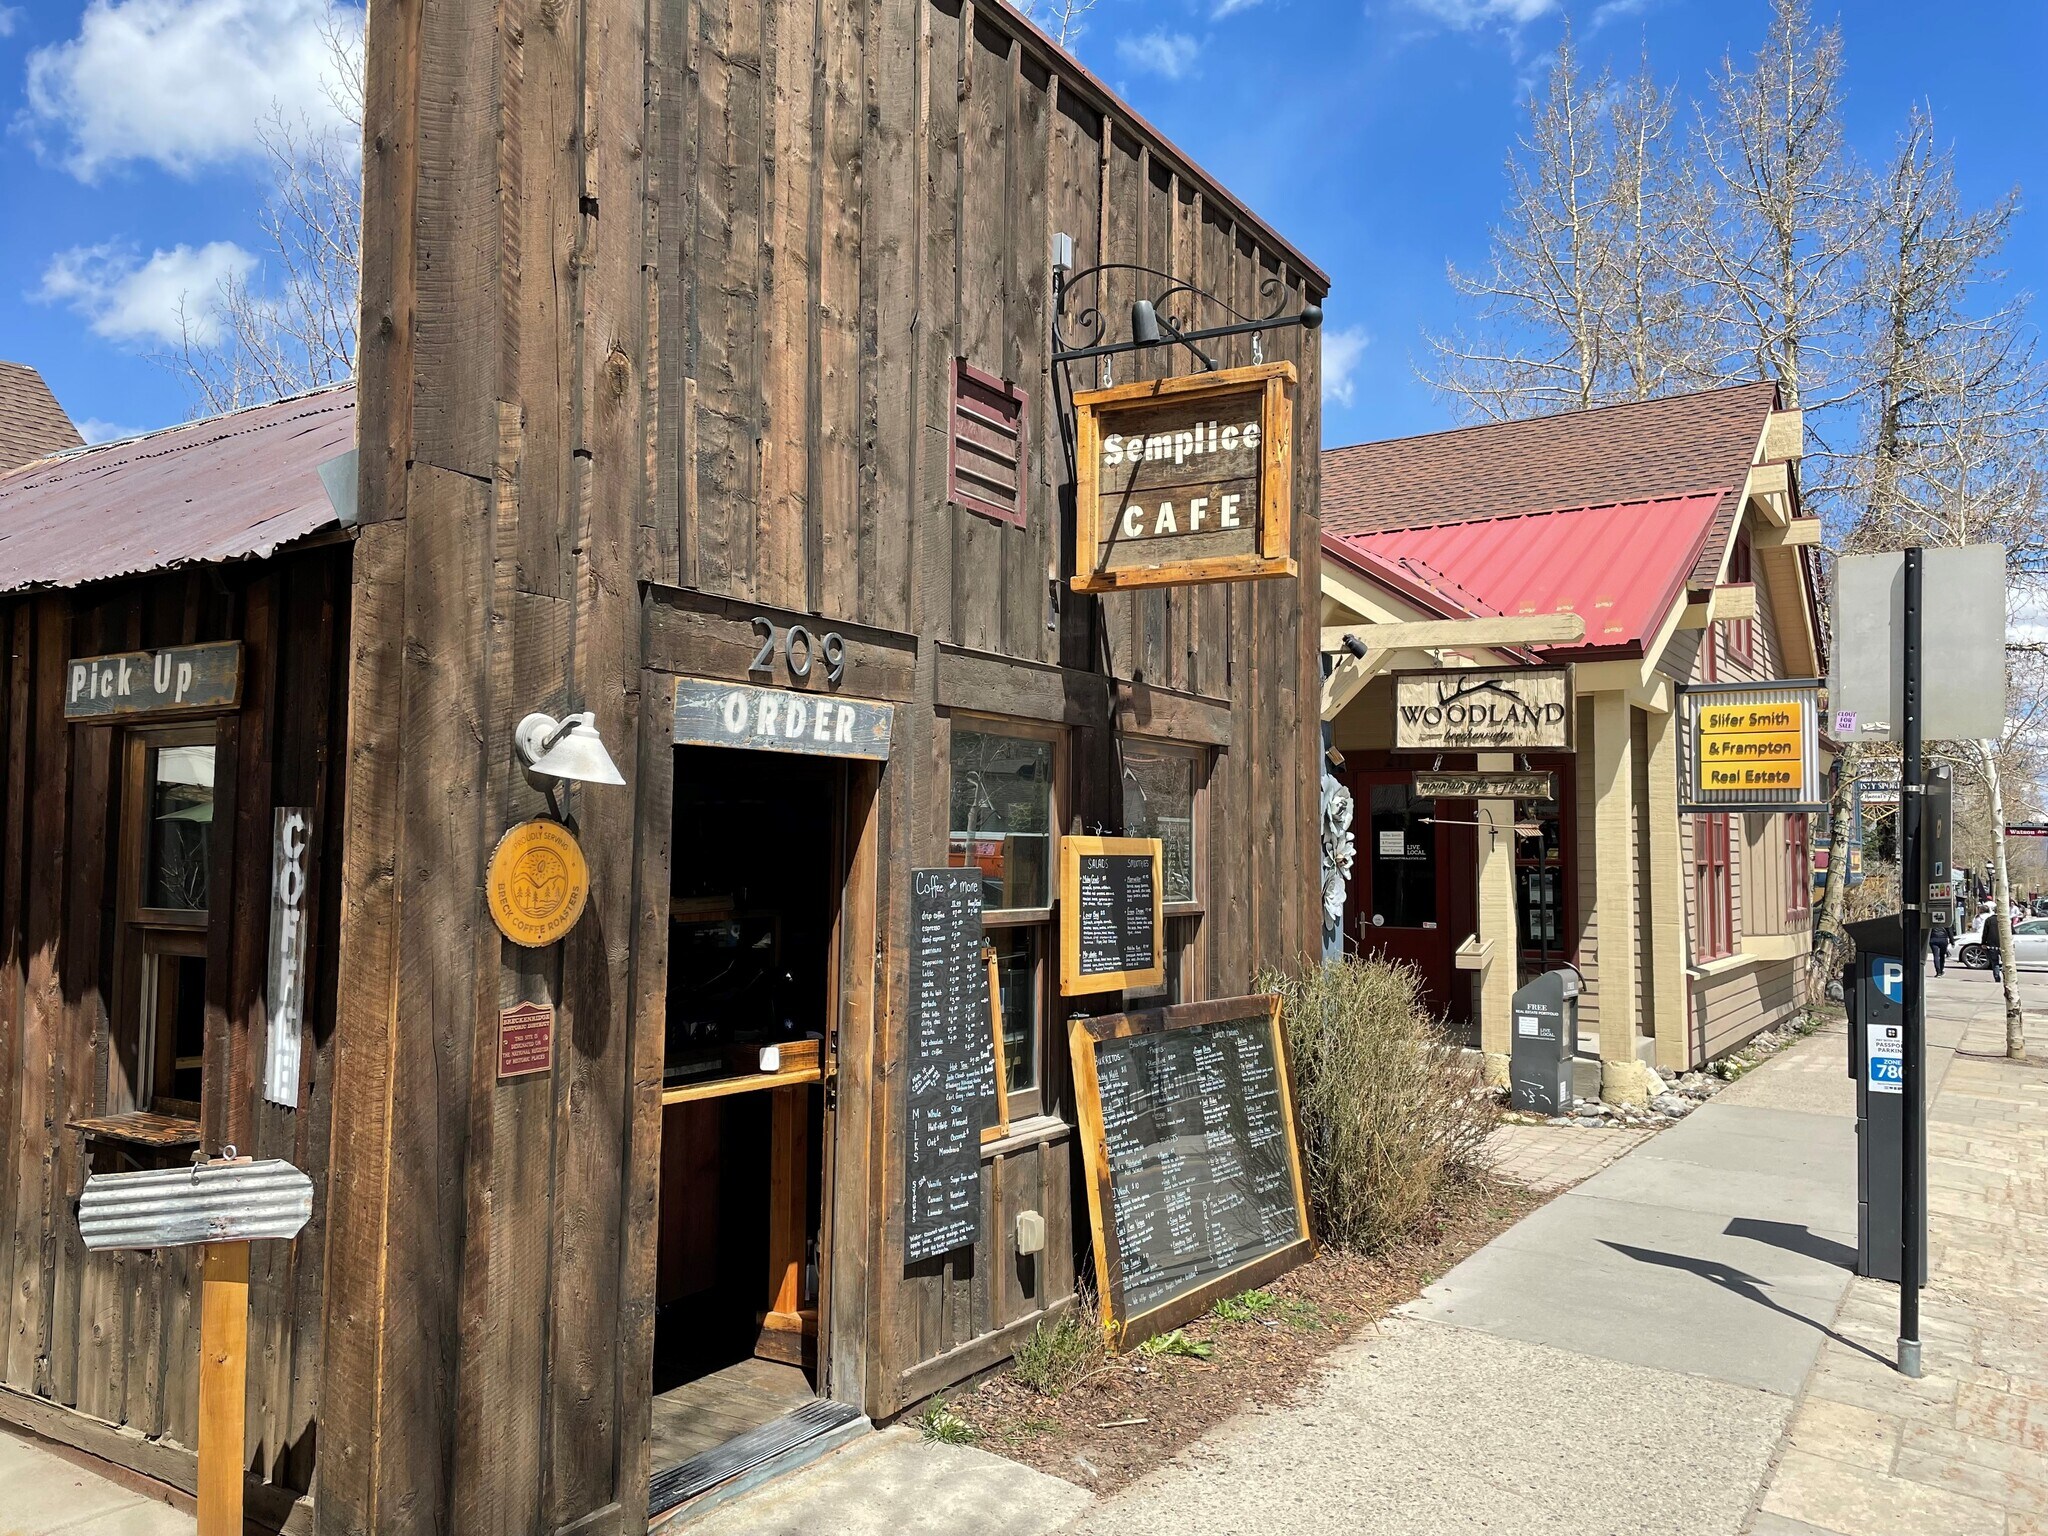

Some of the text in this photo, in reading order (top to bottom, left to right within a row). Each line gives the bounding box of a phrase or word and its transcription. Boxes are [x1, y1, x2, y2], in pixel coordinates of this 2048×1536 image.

[1103, 420, 1262, 465] Semplice
[1123, 494, 1240, 537] CAFE
[748, 616, 845, 682] 209
[71, 653, 192, 703] Pick Up
[724, 691, 856, 743] ORDER
[1400, 703, 1565, 731] WOODLAND
[1709, 712, 1790, 727] Slifer Smith
[1709, 741, 1791, 757] & Frampton
[1711, 769, 1790, 784] Real Estate
[514, 832, 569, 851] PROUDLY SERVING
[1087, 857, 1109, 870] SALADS
[916, 871, 945, 898] Coffee
[498, 883, 580, 934] BRECK COFFEE ROASTERS
[503, 1014, 550, 1026] BRECKENRIDGE
[1527, 1003, 1547, 1011] FREE
[912, 1107, 920, 1163] MILKS
